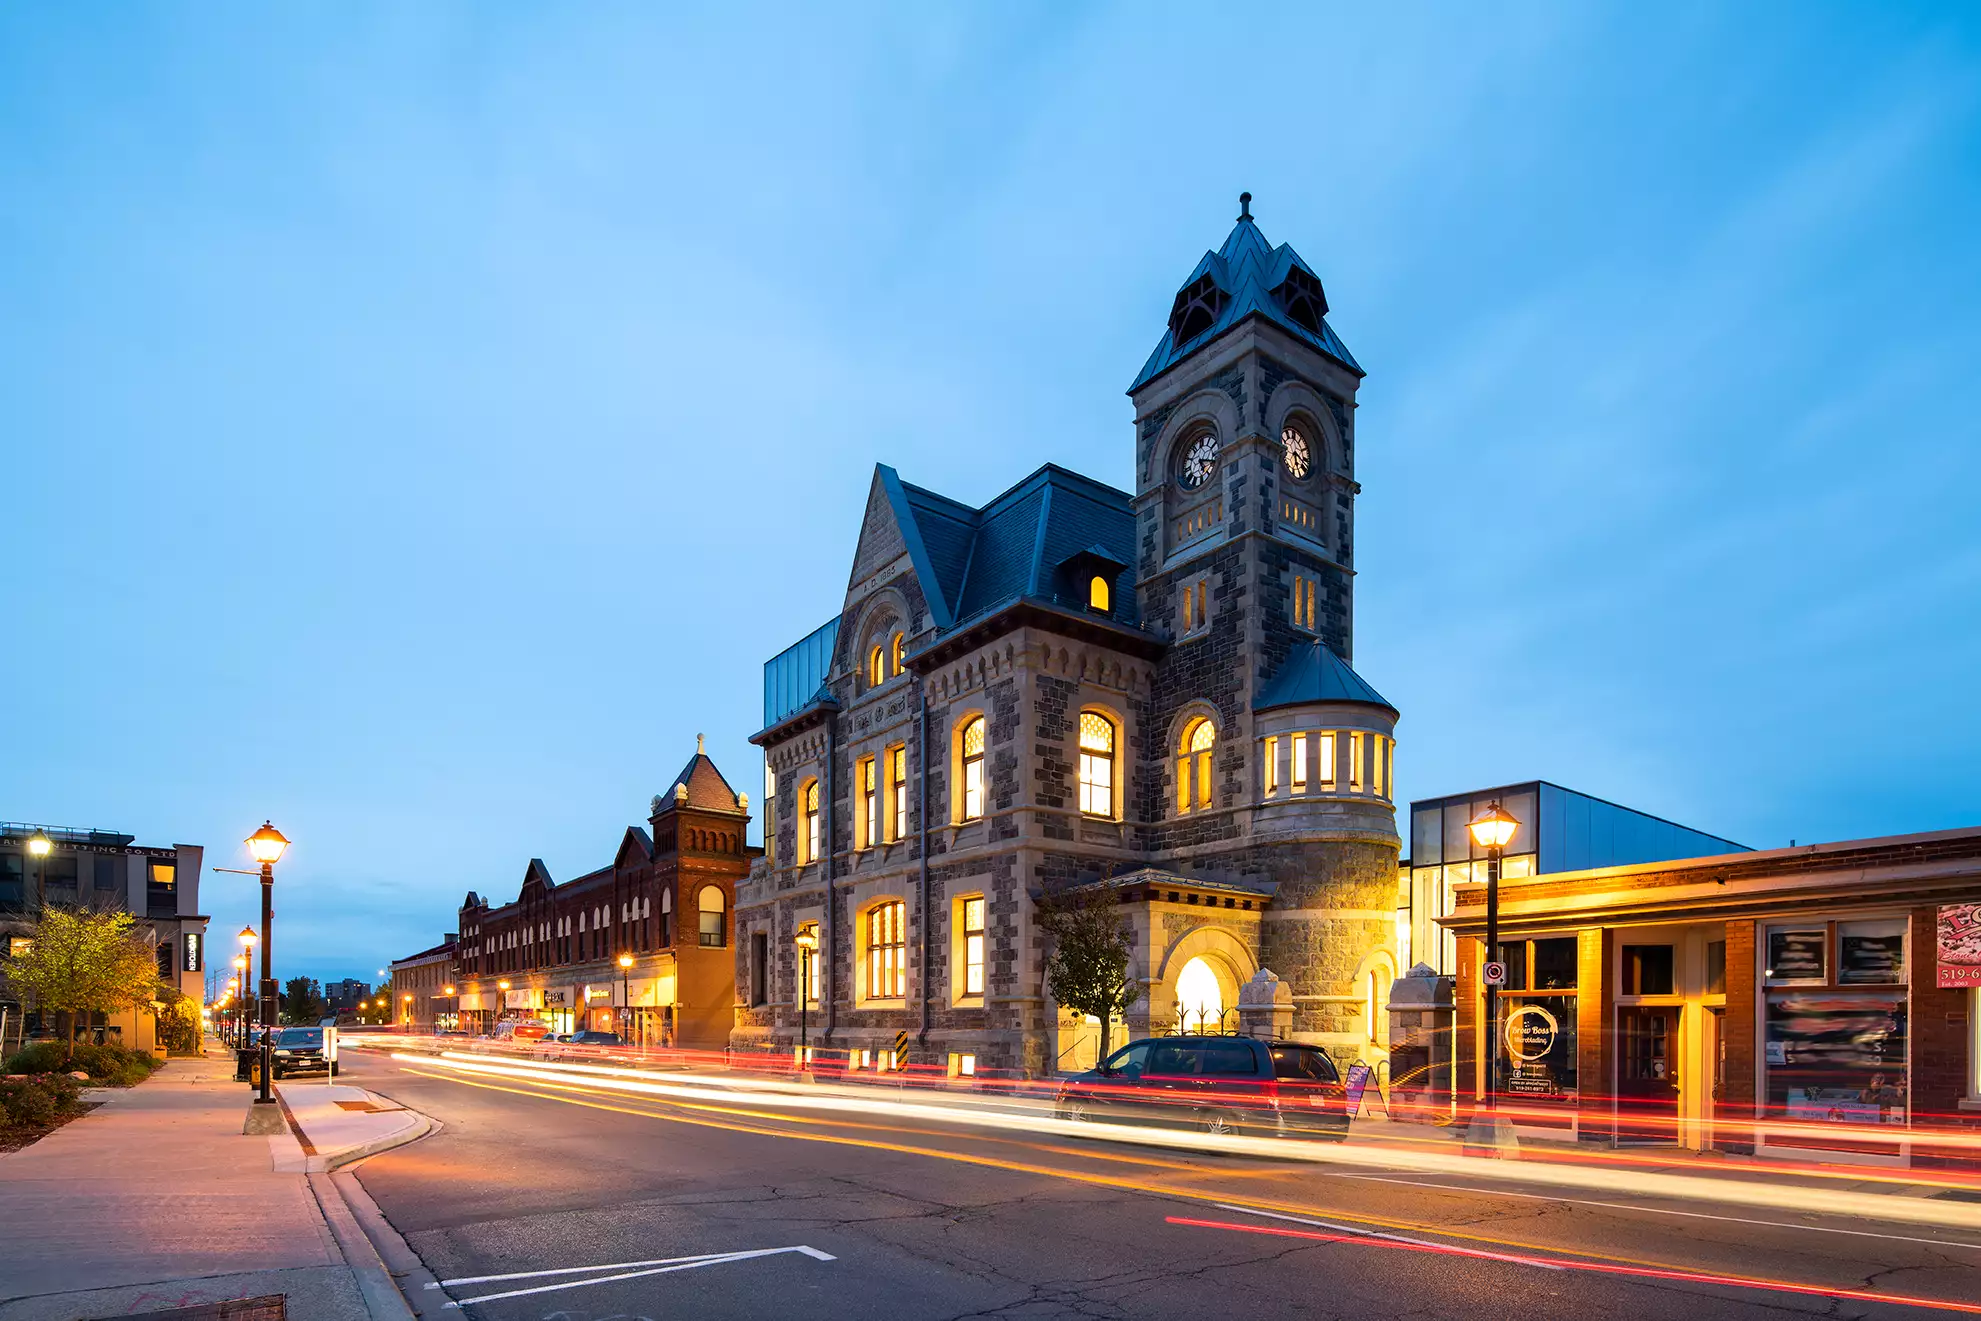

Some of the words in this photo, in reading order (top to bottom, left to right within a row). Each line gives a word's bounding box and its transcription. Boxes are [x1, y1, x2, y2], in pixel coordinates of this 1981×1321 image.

[50, 843, 117, 854] NITTING
[1512, 1026, 1531, 1034] Brow
[1532, 1026, 1549, 1034] Boss
